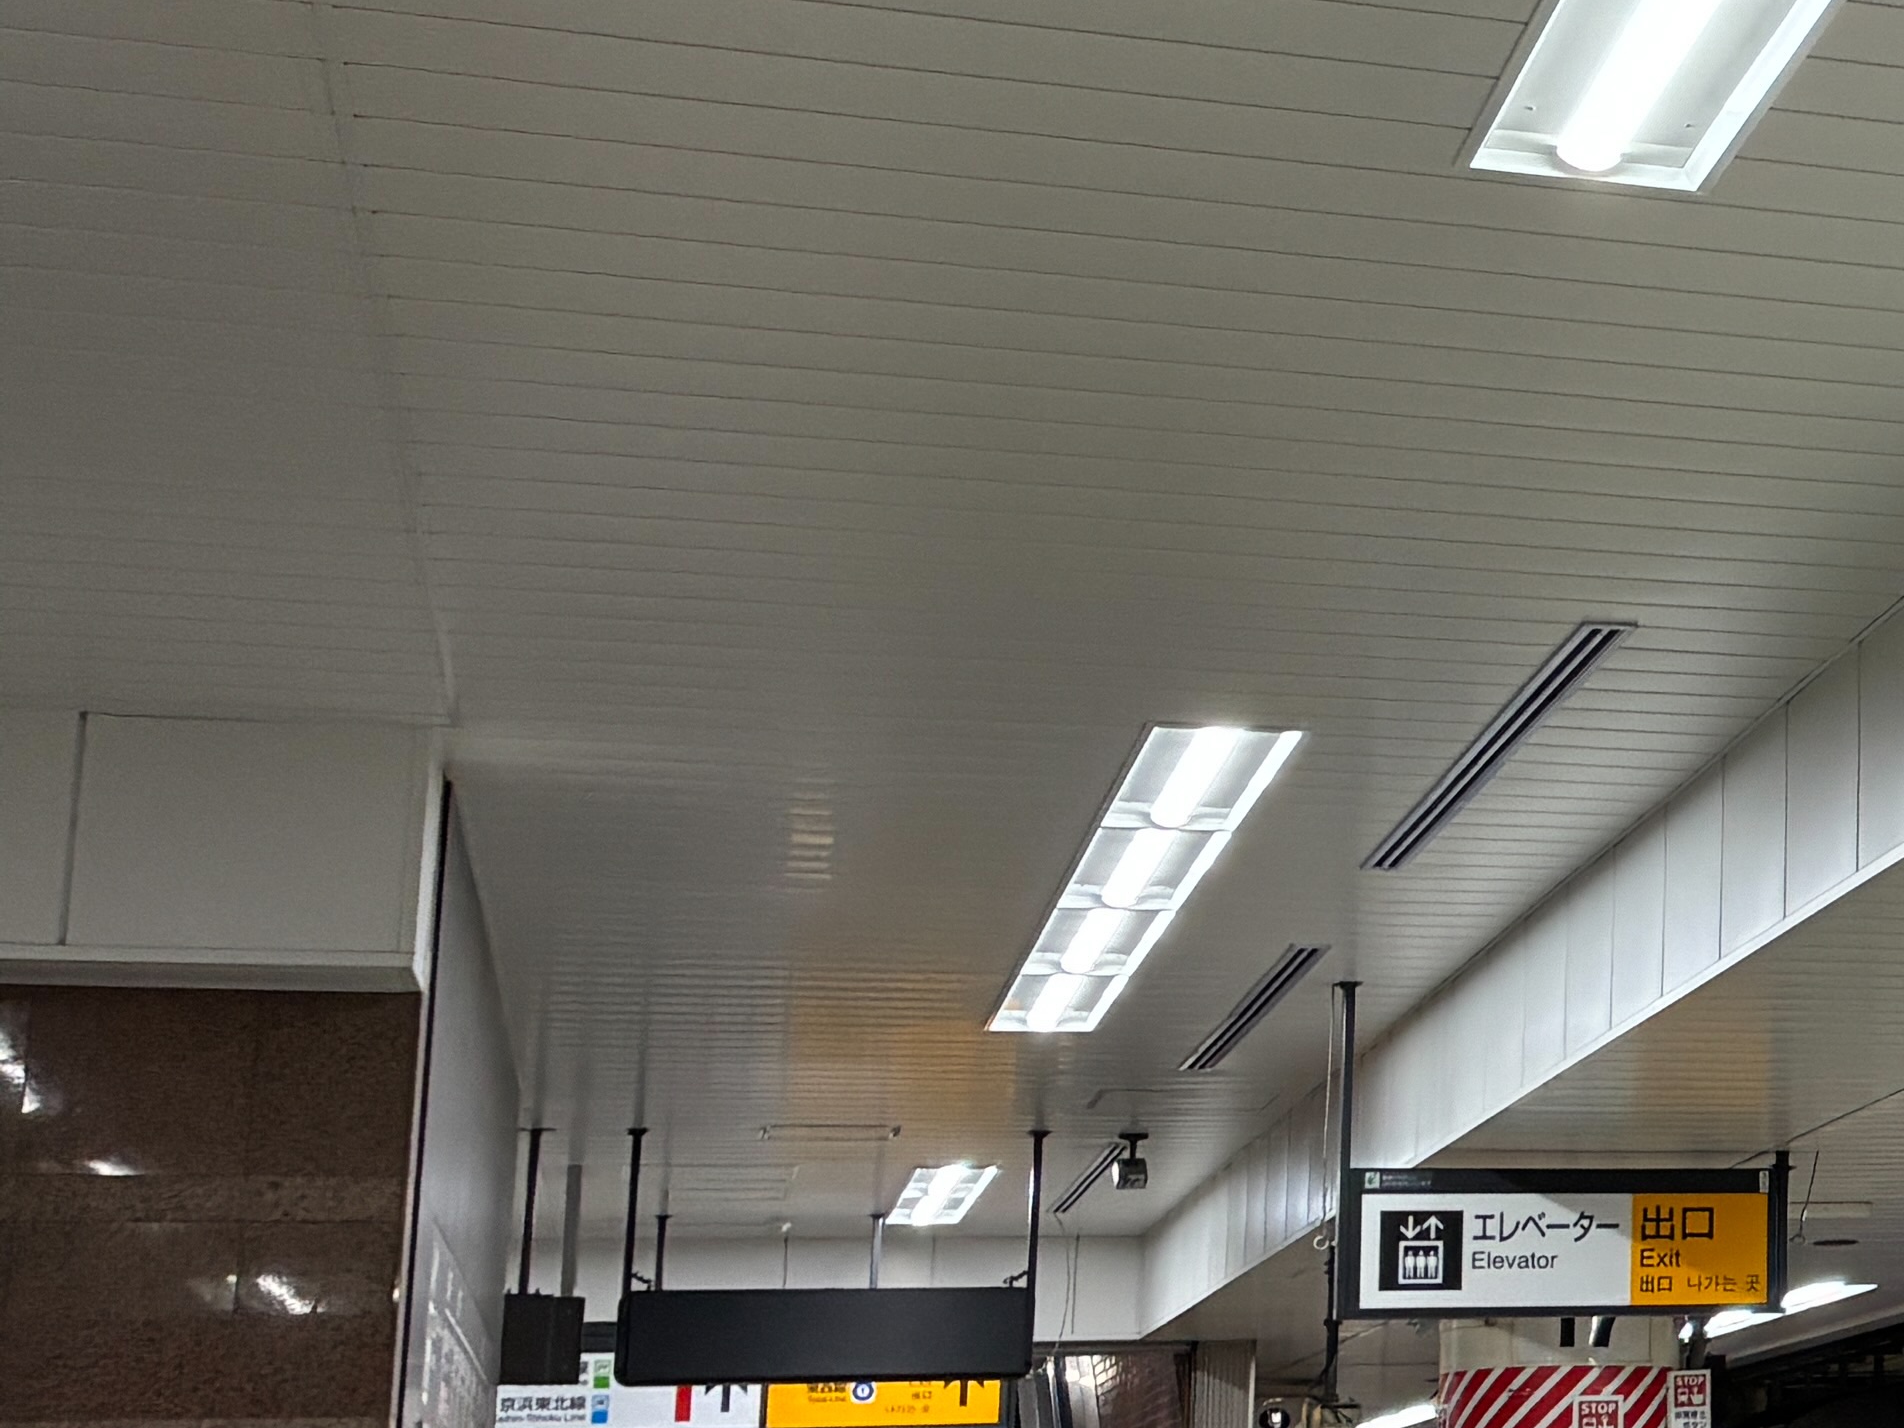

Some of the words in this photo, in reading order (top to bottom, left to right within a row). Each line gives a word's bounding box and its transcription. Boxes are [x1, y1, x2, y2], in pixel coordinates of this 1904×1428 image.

[1472, 1211, 1620, 1242] エレベーター
[1640, 1205, 1715, 1241] 出口
[1472, 1251, 1558, 1269] Elevator
[1640, 1248, 1680, 1268] Exit
[1640, 1275, 1673, 1293] 出口
[1687, 1275, 1737, 1293] 나가는
[1746, 1275, 1761, 1293] 곳
[1676, 1376, 1704, 1386] STOP
[1581, 1403, 1616, 1415] STOP
